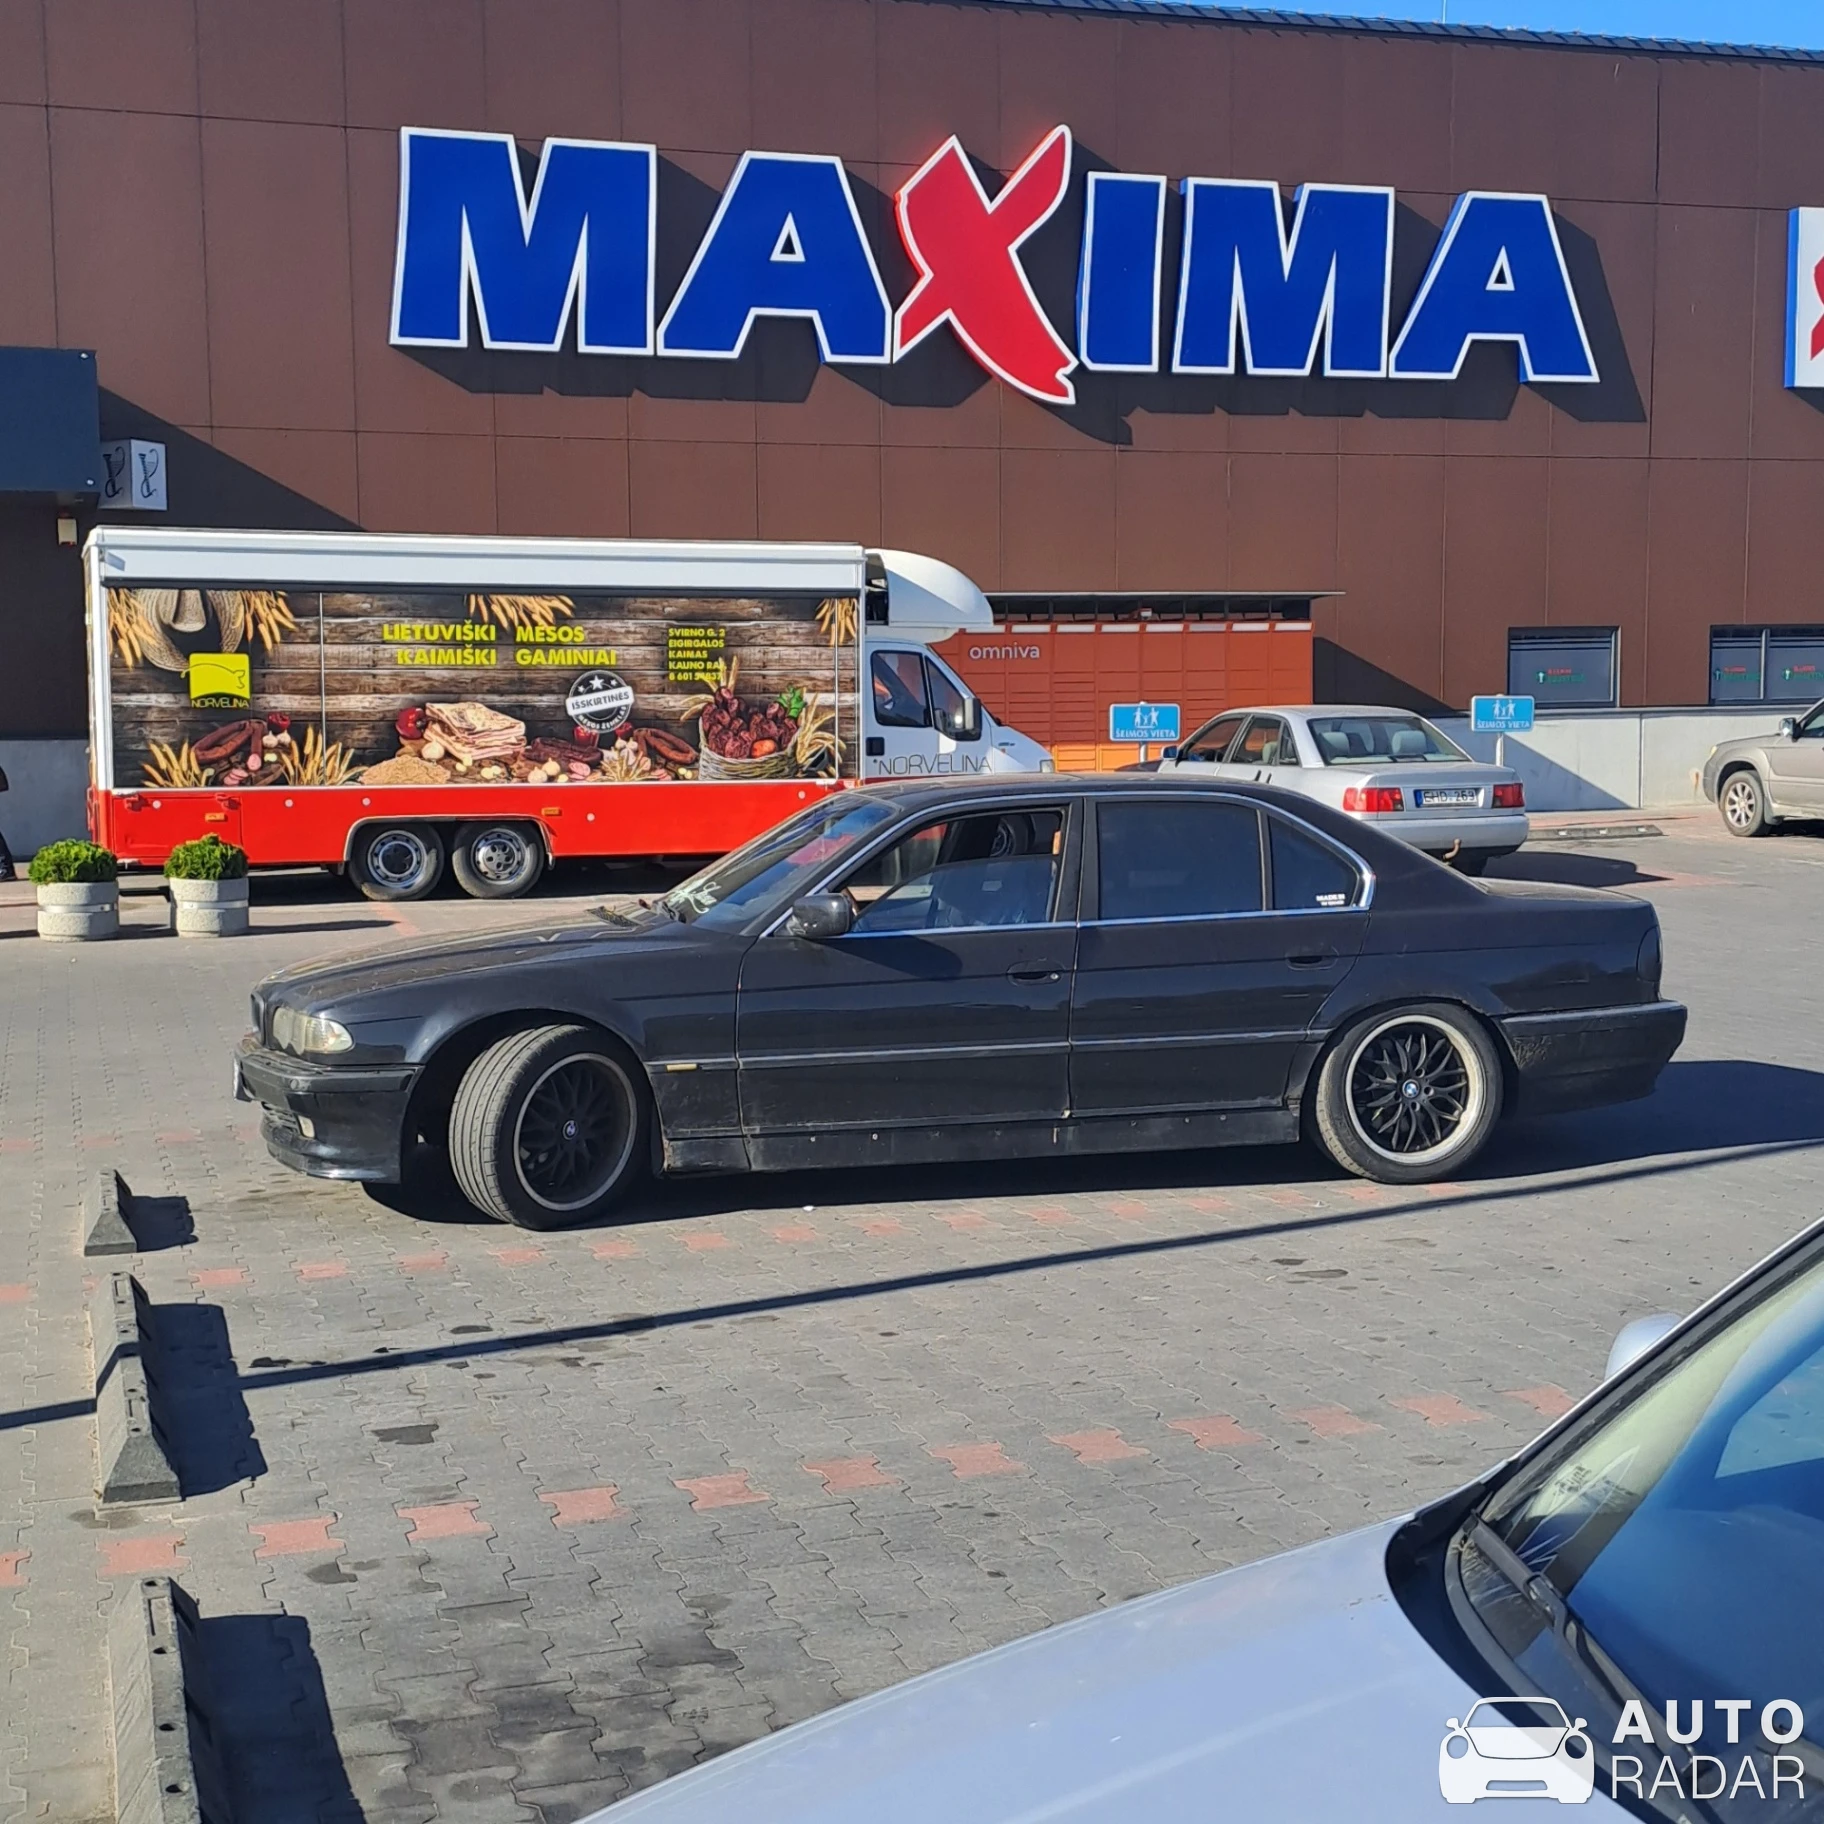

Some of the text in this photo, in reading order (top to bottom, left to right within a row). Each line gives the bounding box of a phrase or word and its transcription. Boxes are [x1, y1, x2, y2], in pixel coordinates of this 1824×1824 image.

[389, 124, 1601, 405] MAXIMA
[383, 619, 496, 642] LIETUVIŠKI
[668, 628, 726, 637] SVIRNO G. 2
[397, 643, 617, 666] KAIMIŠKI GAMINIAI
[668, 650, 708, 659] KAIMAS
[969, 642, 1041, 660] omniva
[668, 661, 705, 670] KAUNO
[191, 697, 249, 708] NORVELINA
[1115, 728, 1176, 738] ŠEIMOS VIETA
[878, 753, 992, 775] NORVELINA
